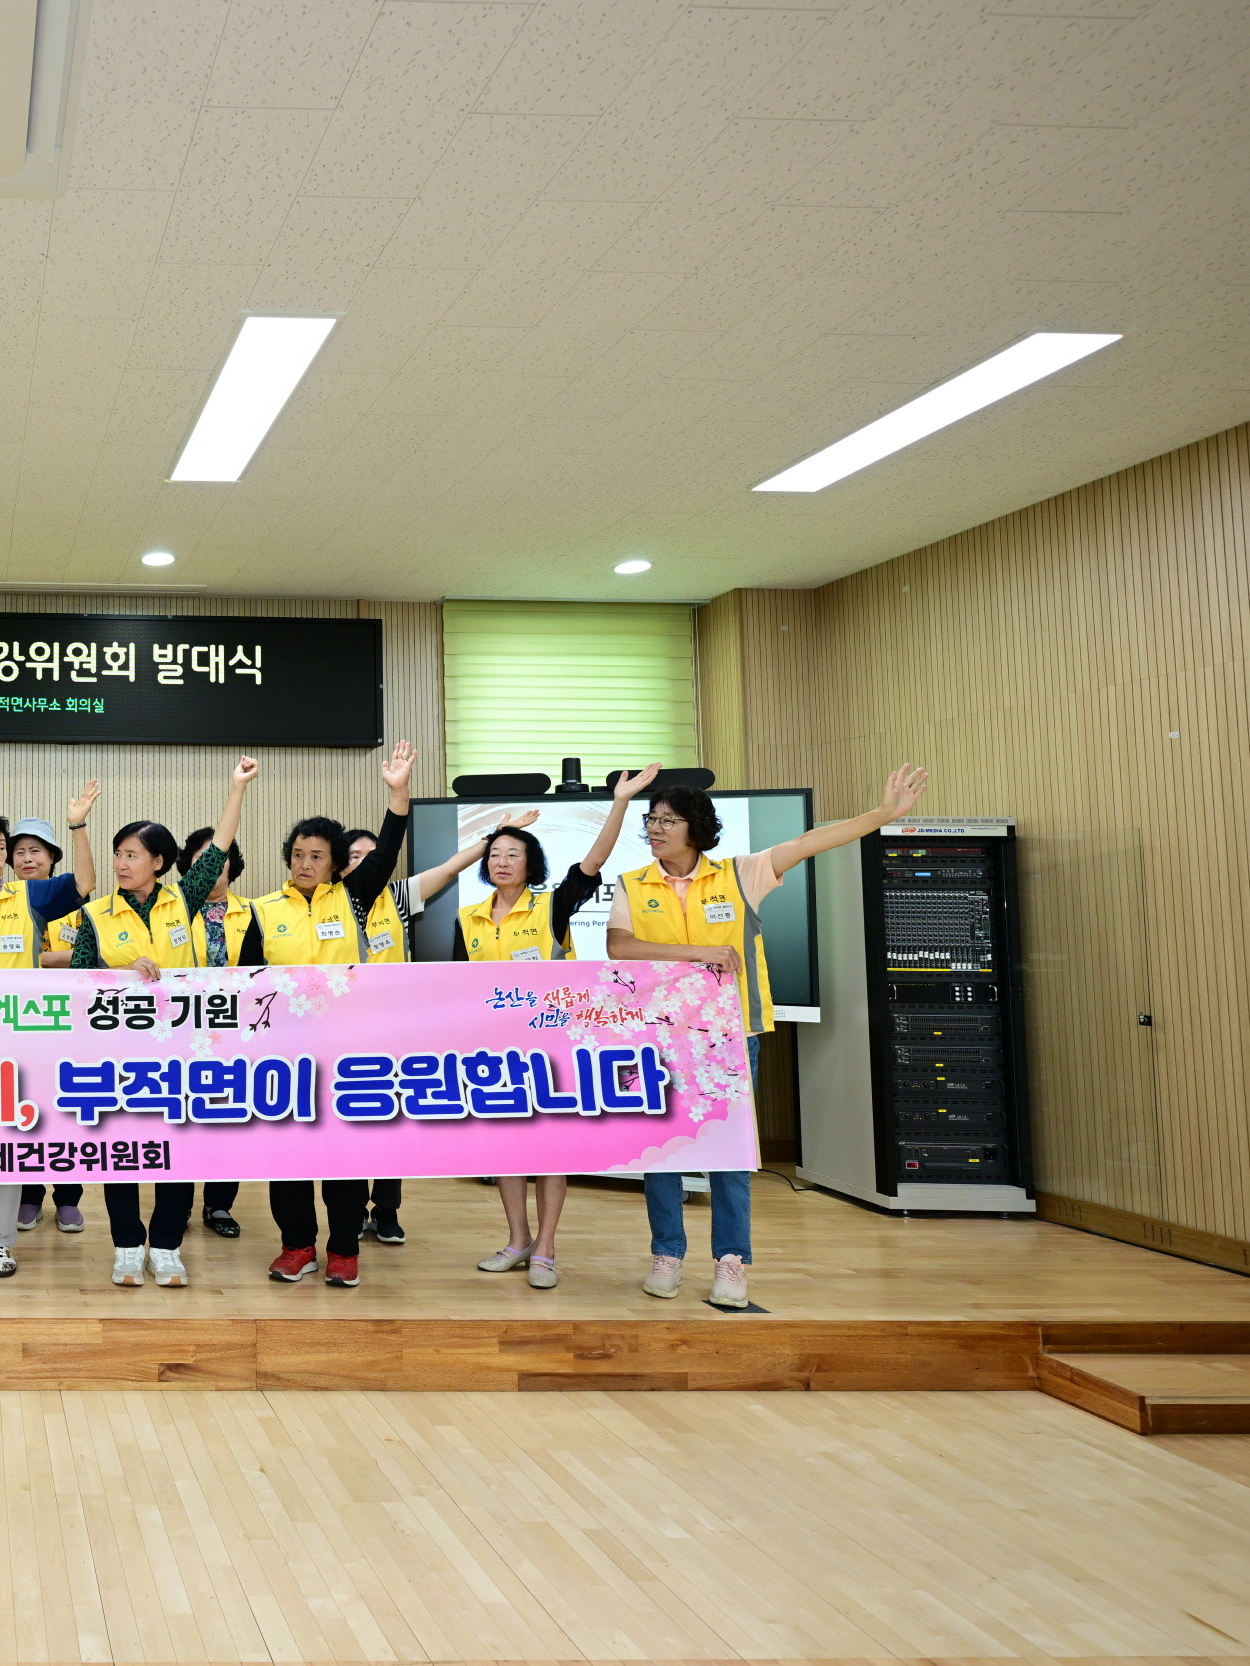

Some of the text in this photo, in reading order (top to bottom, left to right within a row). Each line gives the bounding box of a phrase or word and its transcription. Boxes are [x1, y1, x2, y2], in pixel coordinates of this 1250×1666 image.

[152, 643, 262, 686] 발대식
[65, 696, 105, 714] 회의실
[701, 893, 727, 905] 부적면
[570, 920, 590, 928] ering
[485, 986, 591, 1010] 논산을 새롭게
[87, 994, 157, 1031] 성공
[170, 994, 240, 1029] 기원
[528, 1005, 645, 1029] 시민을 행복하게
[56, 1057, 314, 1122] 부적면이
[334, 1047, 666, 1118] 응원합니다
